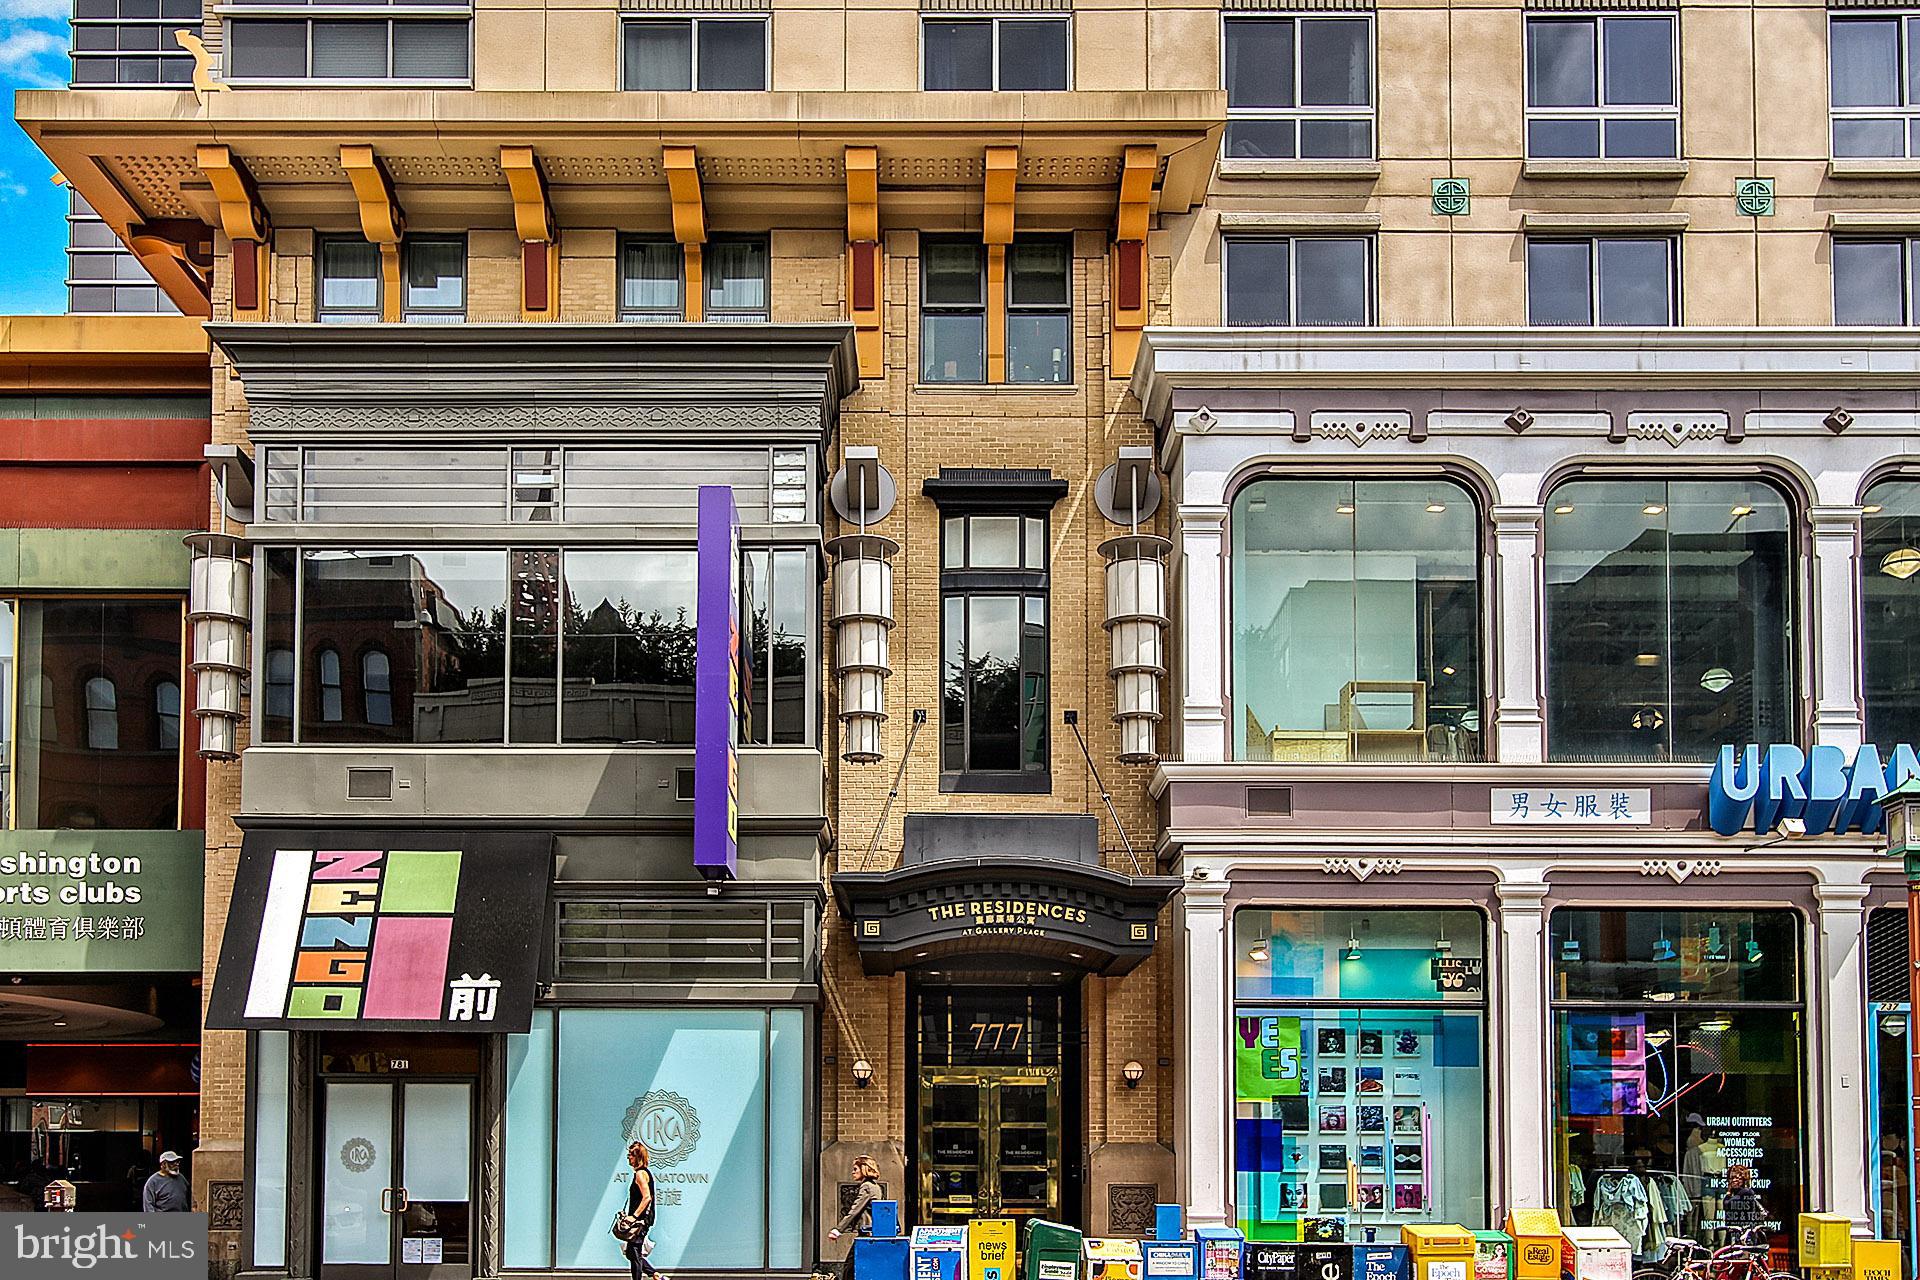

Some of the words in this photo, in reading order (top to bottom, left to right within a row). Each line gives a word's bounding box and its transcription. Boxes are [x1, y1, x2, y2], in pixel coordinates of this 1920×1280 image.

[1510, 791, 1633, 820] 男女服裝
[59, 881, 142, 904] clubs
[928, 904, 966, 921] THE
[970, 901, 1087, 923] RESIDENCES
[287, 850, 384, 1019] ZENGO
[449, 973, 501, 1020] 前
[969, 1024, 1023, 1050] 777
[390, 1060, 409, 1069] 781
[1706, 1116, 1731, 1127] URBAN
[1731, 1116, 1773, 1127] OUTFITTERS
[1723, 1137, 1756, 1148] WOMENS
[1716, 1147, 1764, 1158] ACCESSORIES
[1727, 1158, 1753, 1168] BEAUTY
[613, 1173, 629, 1183] AT
[978, 1241, 1008, 1251] news
[981, 1250, 1005, 1261] brief
[1365, 1261, 1386, 1272] The
